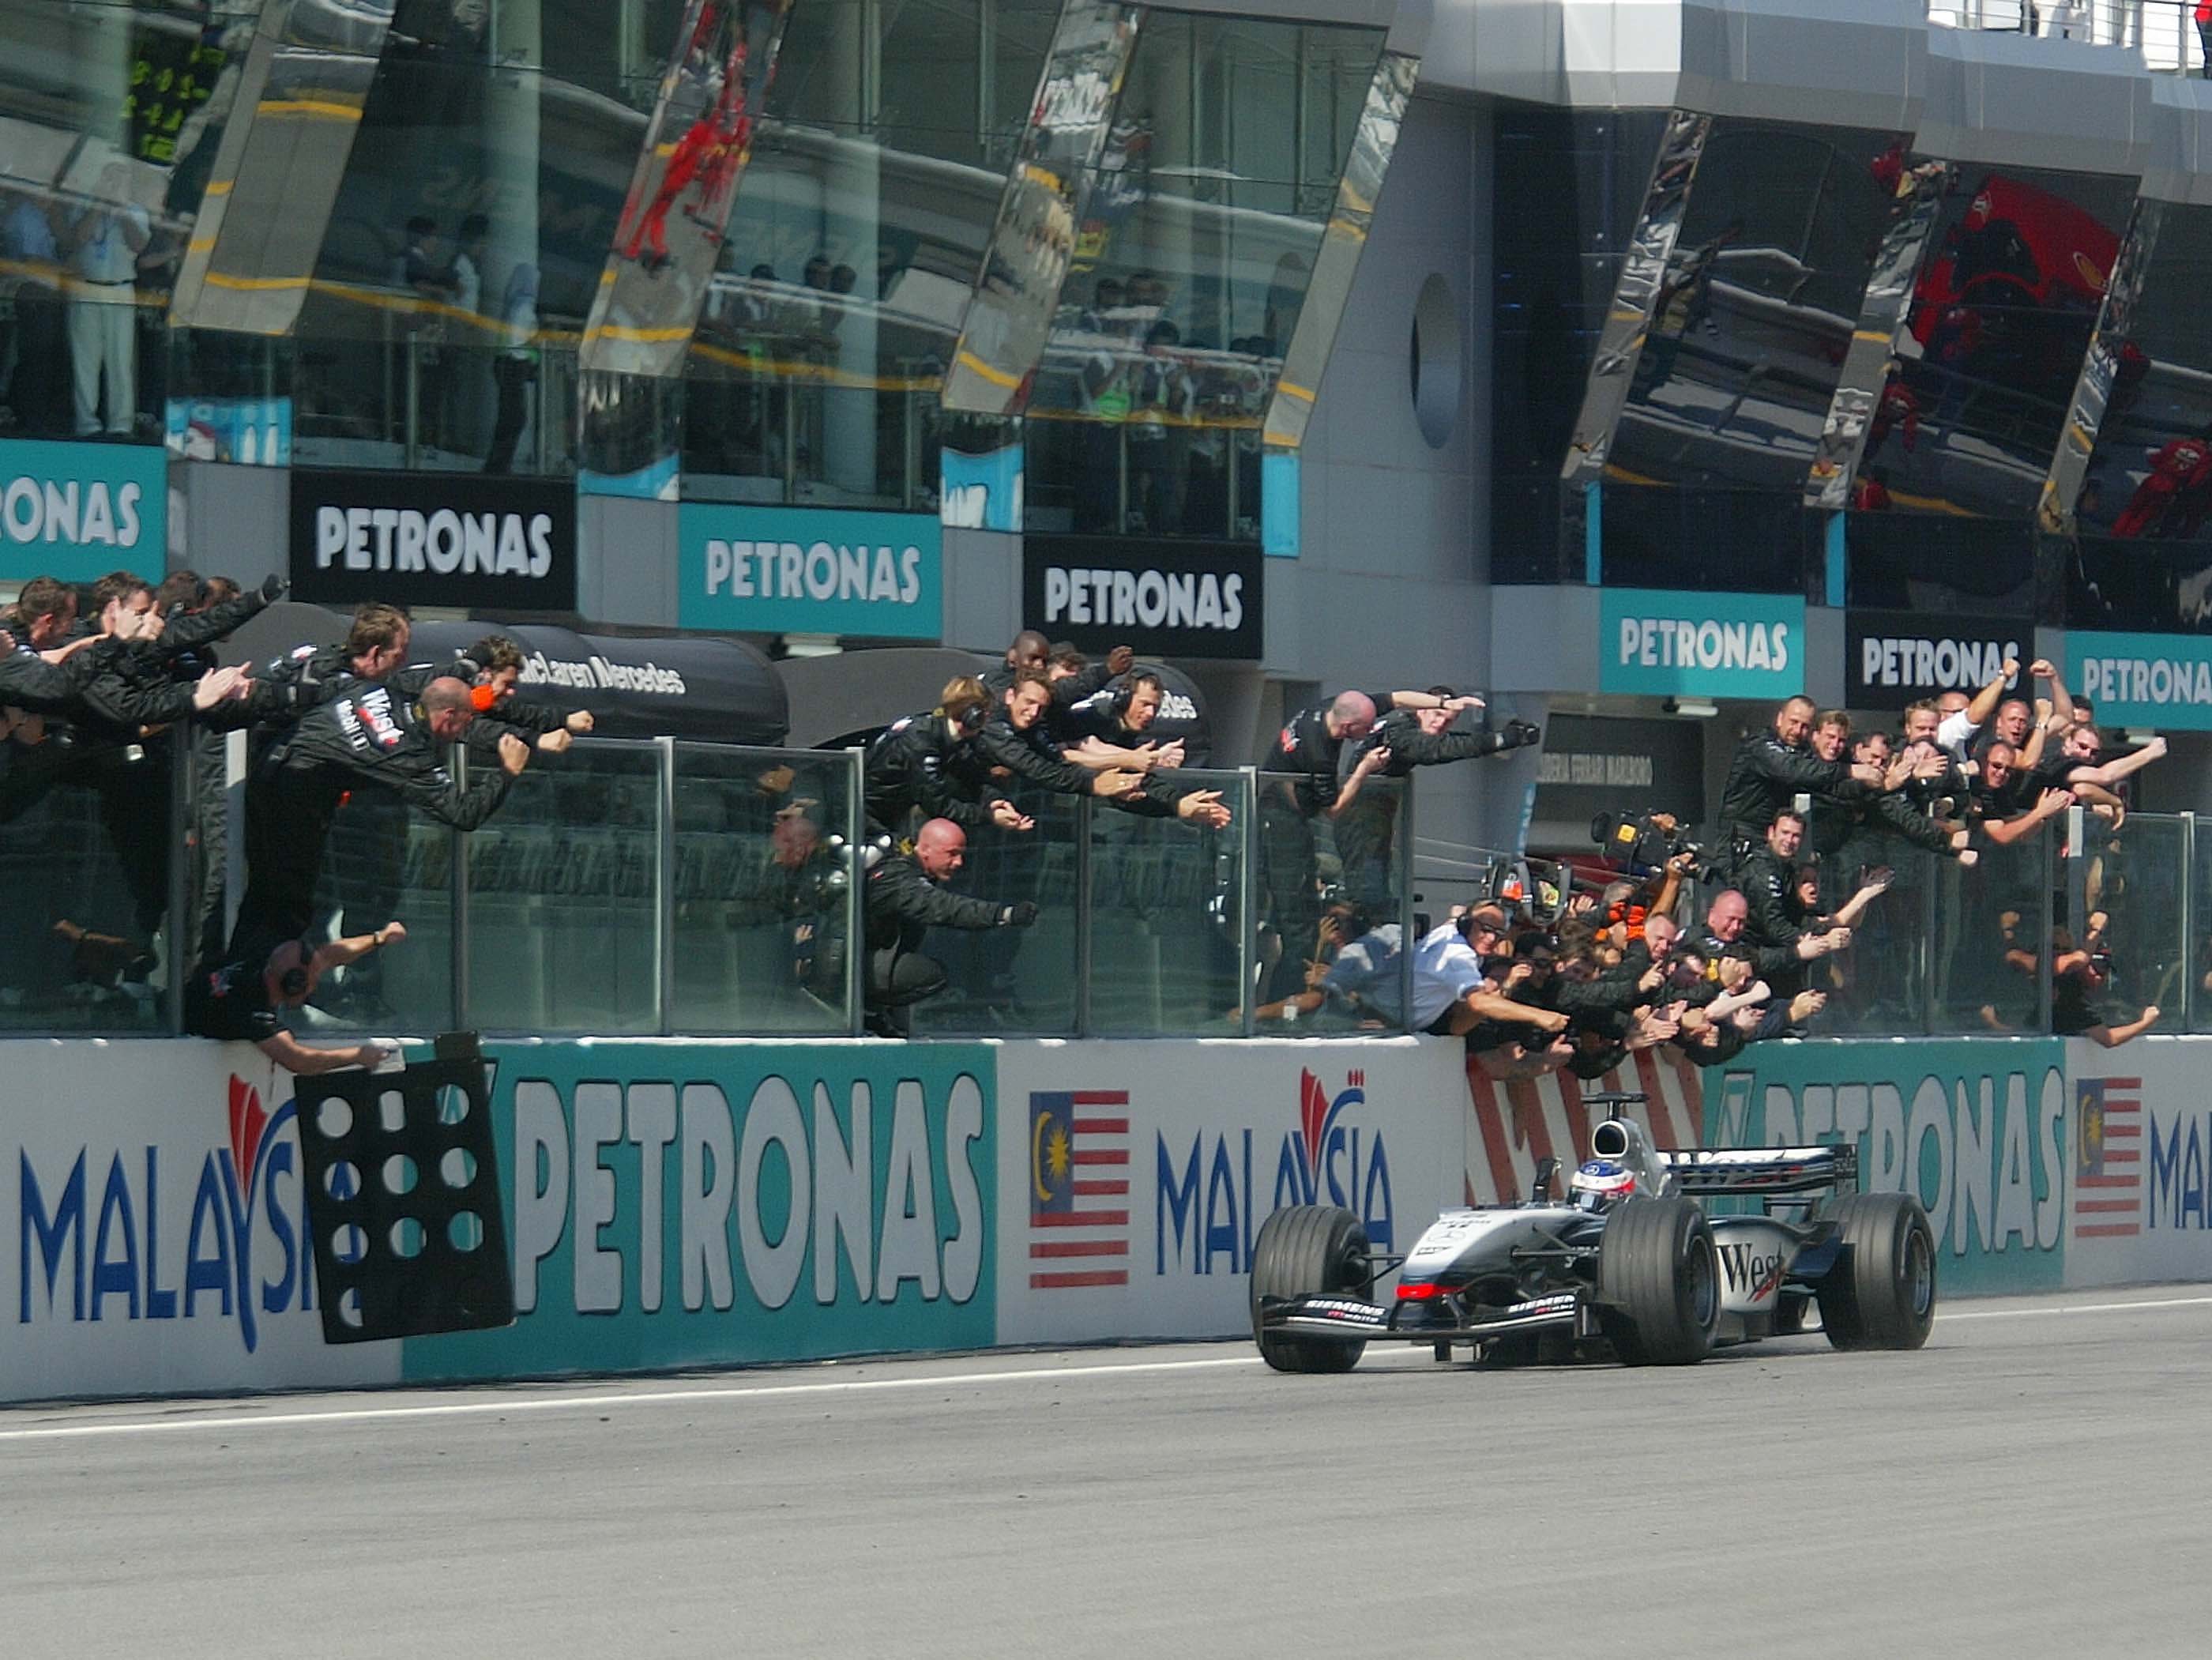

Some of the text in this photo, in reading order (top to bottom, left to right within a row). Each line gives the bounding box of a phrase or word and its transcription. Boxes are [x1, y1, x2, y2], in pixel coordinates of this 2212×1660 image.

[0, 476, 141, 547] ONAS
[318, 506, 551, 578] PETRONAS
[707, 540, 920, 602] PETRONAS
[1045, 567, 1243, 630] PETRONAS
[1621, 617, 1788, 671] PETRONAS
[1862, 637, 2018, 690] PETRONAS
[589, 655, 686, 694] Mercedes
[2083, 657, 2212, 704] PETRONA
[514, 1075, 984, 1312] PETRONAS
[2149, 1109, 2212, 1229] MA
[1715, 1241, 1785, 1293] West
[1304, 1300, 1386, 1316] SIEMENS
